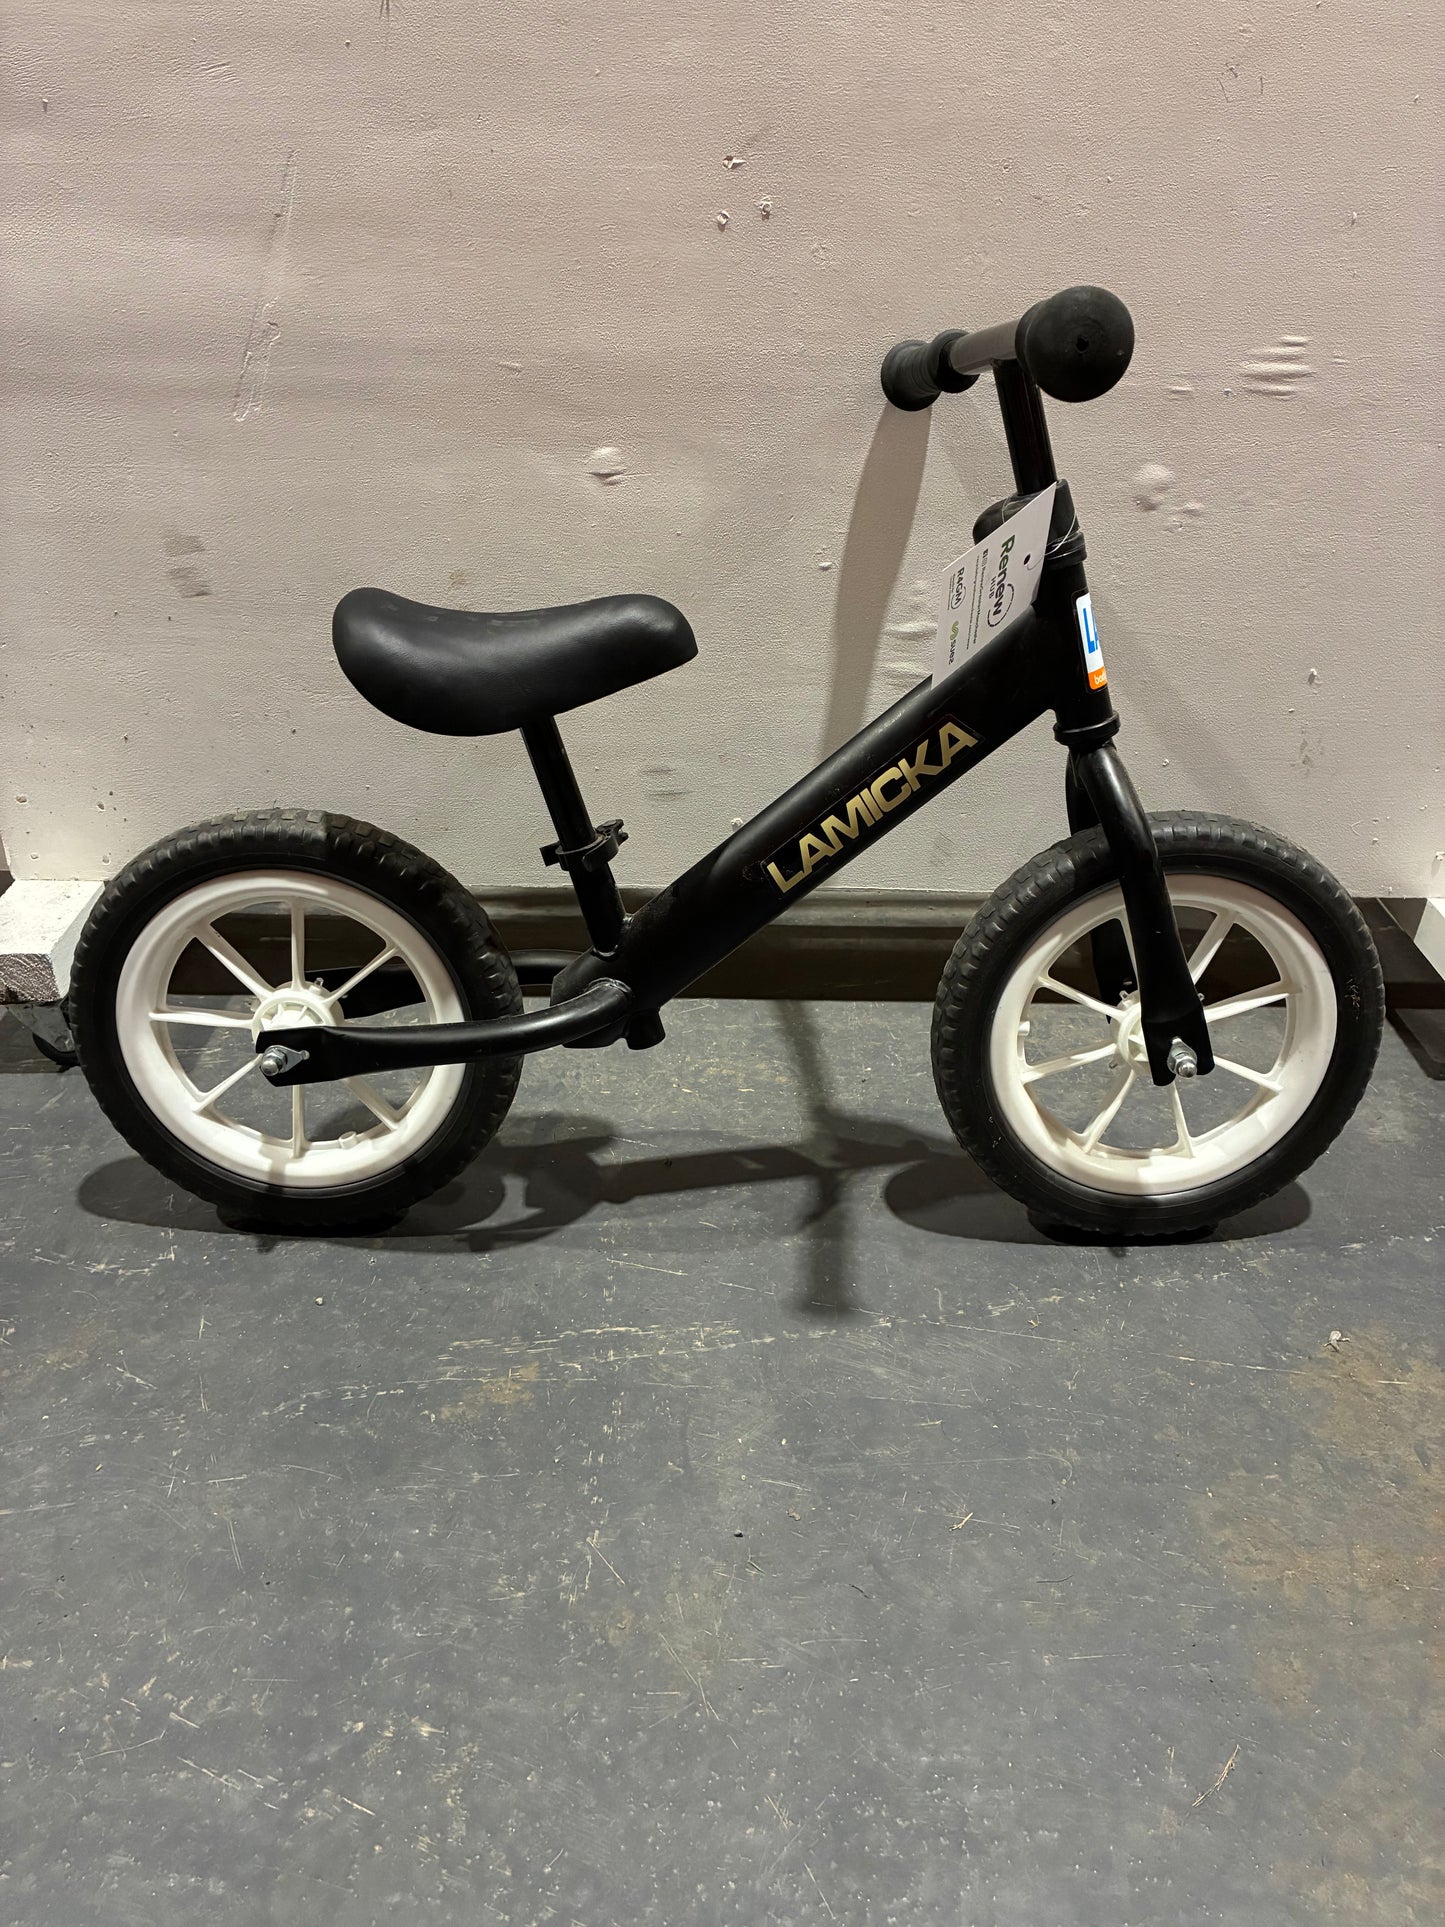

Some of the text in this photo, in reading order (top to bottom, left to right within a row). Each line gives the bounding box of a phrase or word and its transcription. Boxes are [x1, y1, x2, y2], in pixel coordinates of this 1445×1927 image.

[954, 566, 966, 606] R4GM
[988, 576, 997, 599] HUB
[993, 534, 1016, 616] Renew
[767, 721, 979, 893] LAMICKA
